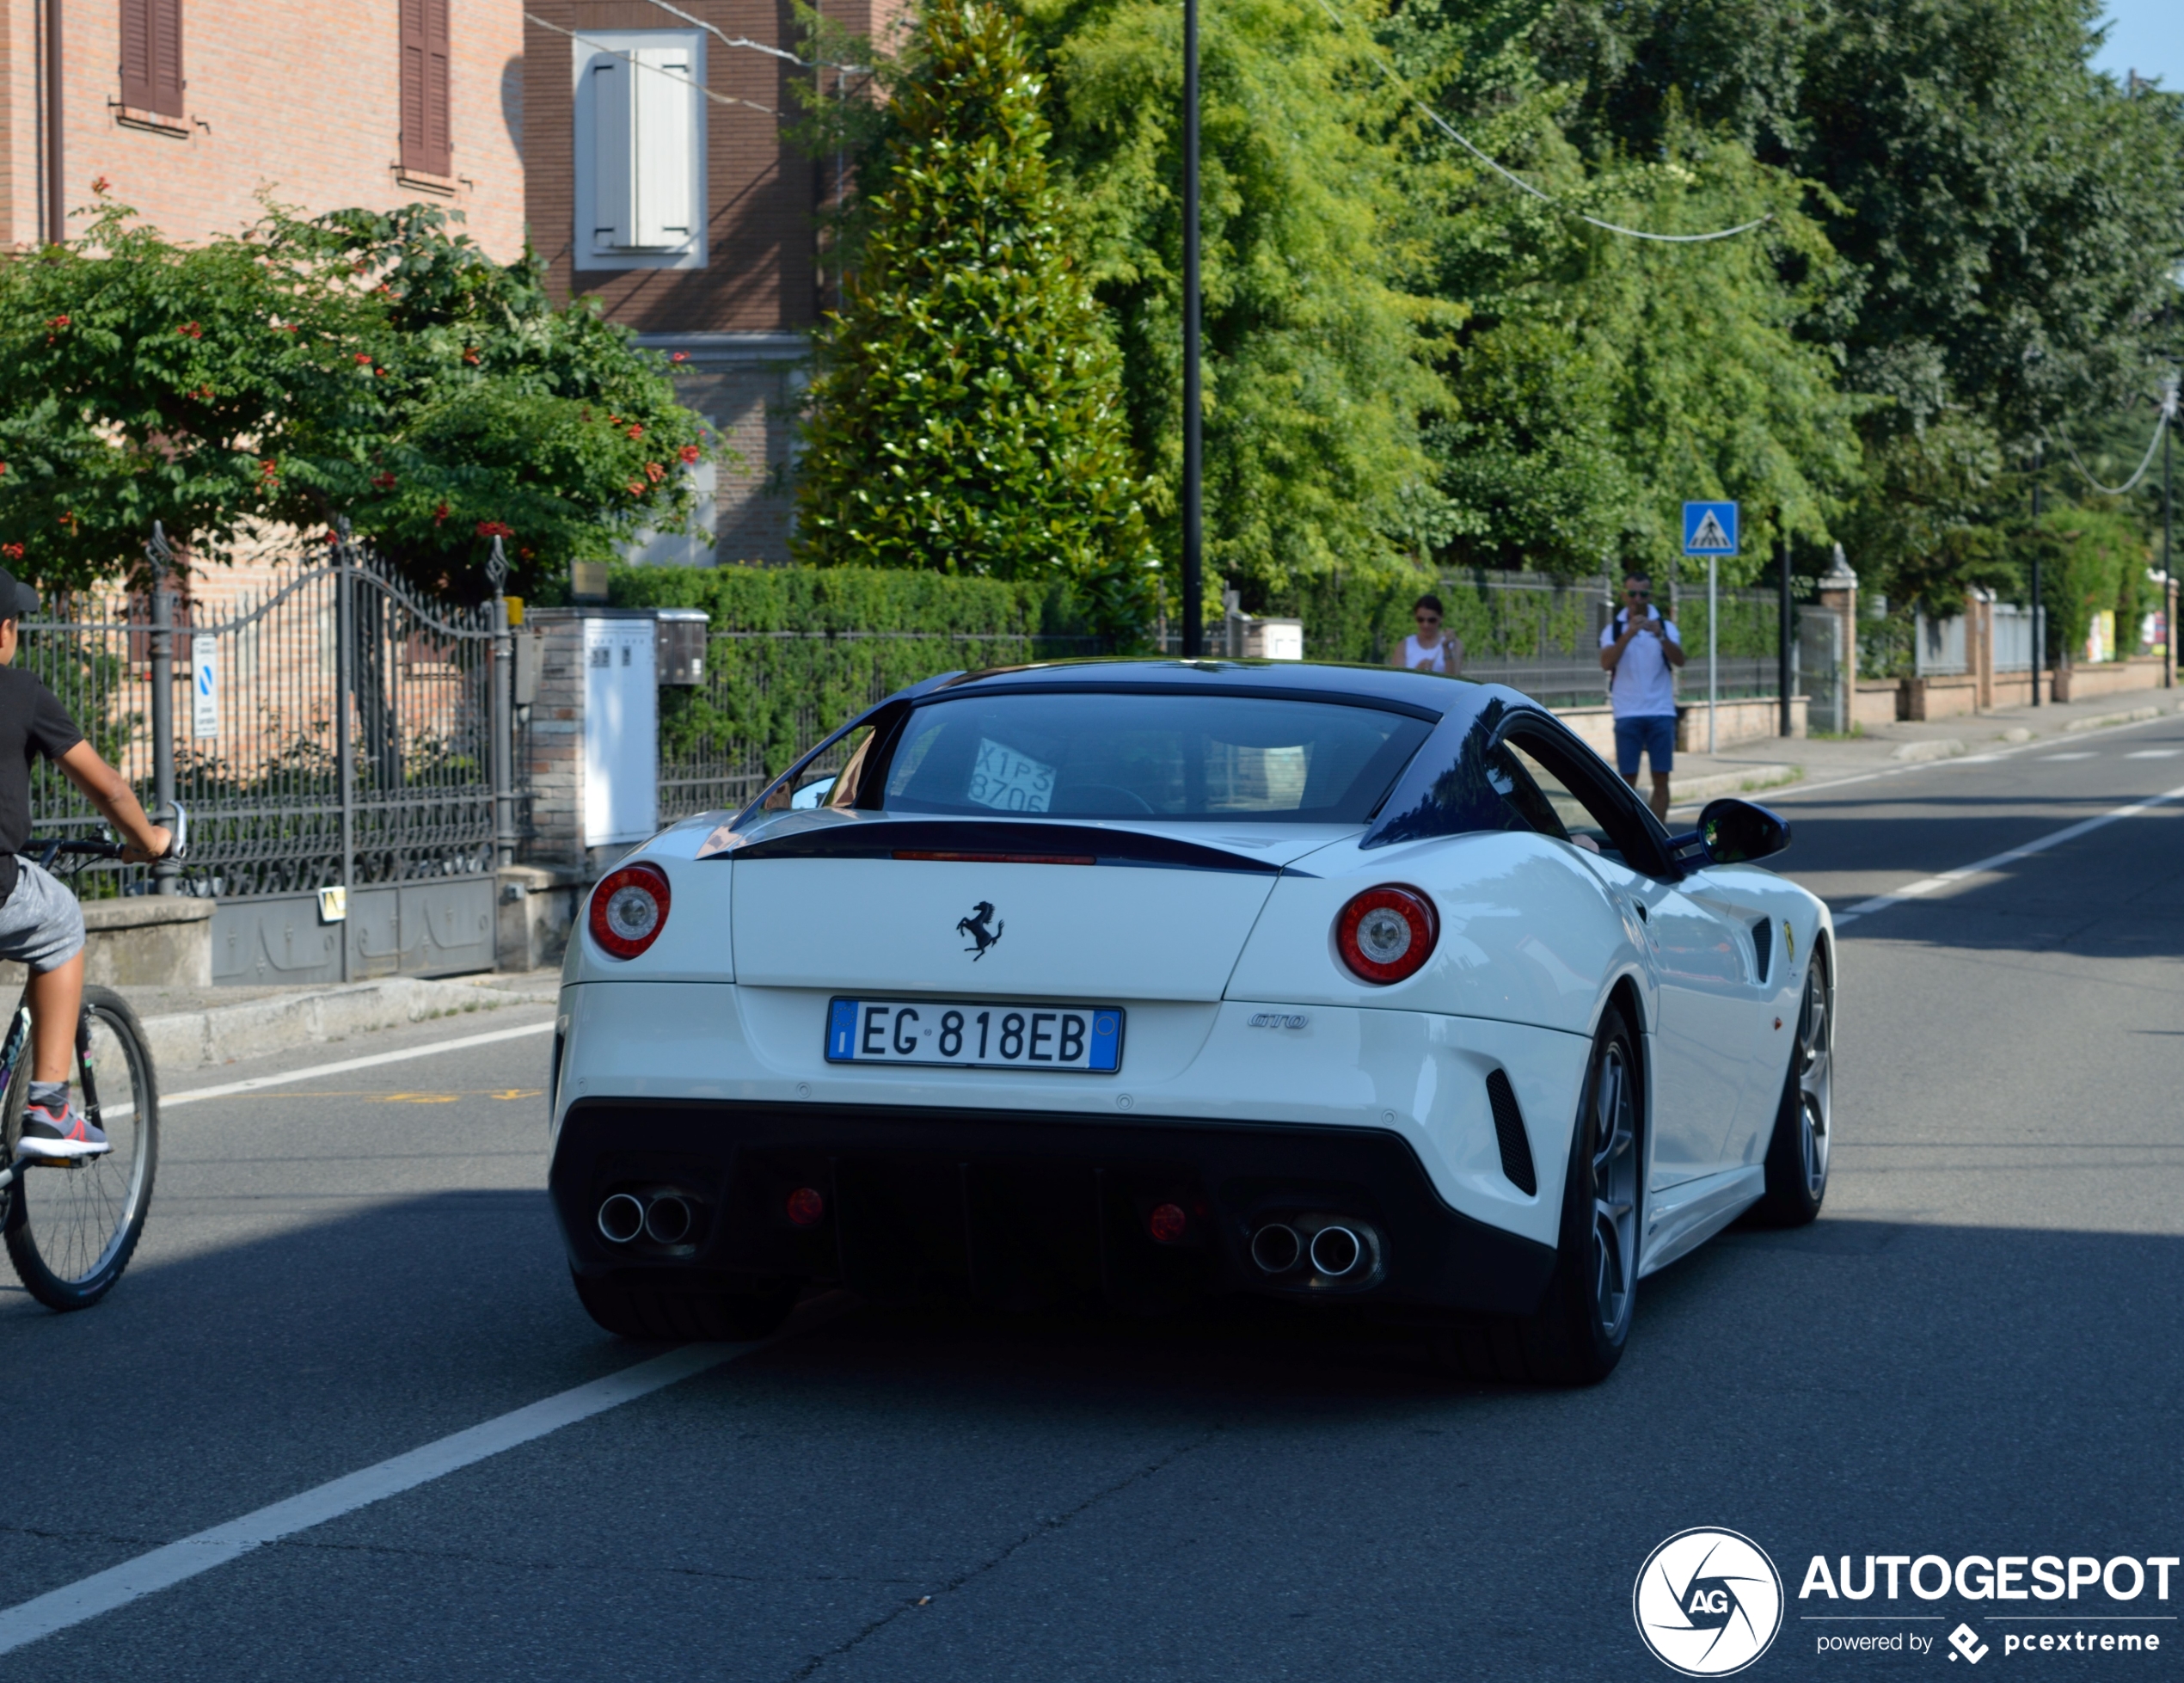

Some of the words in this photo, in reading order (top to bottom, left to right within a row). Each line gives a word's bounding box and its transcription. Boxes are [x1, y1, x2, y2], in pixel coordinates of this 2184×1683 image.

[838, 1031, 846, 1053] I
[862, 1006, 919, 1055] EG
[938, 1010, 1086, 1062] 818EB
[1248, 1013, 1309, 1029] GTO
